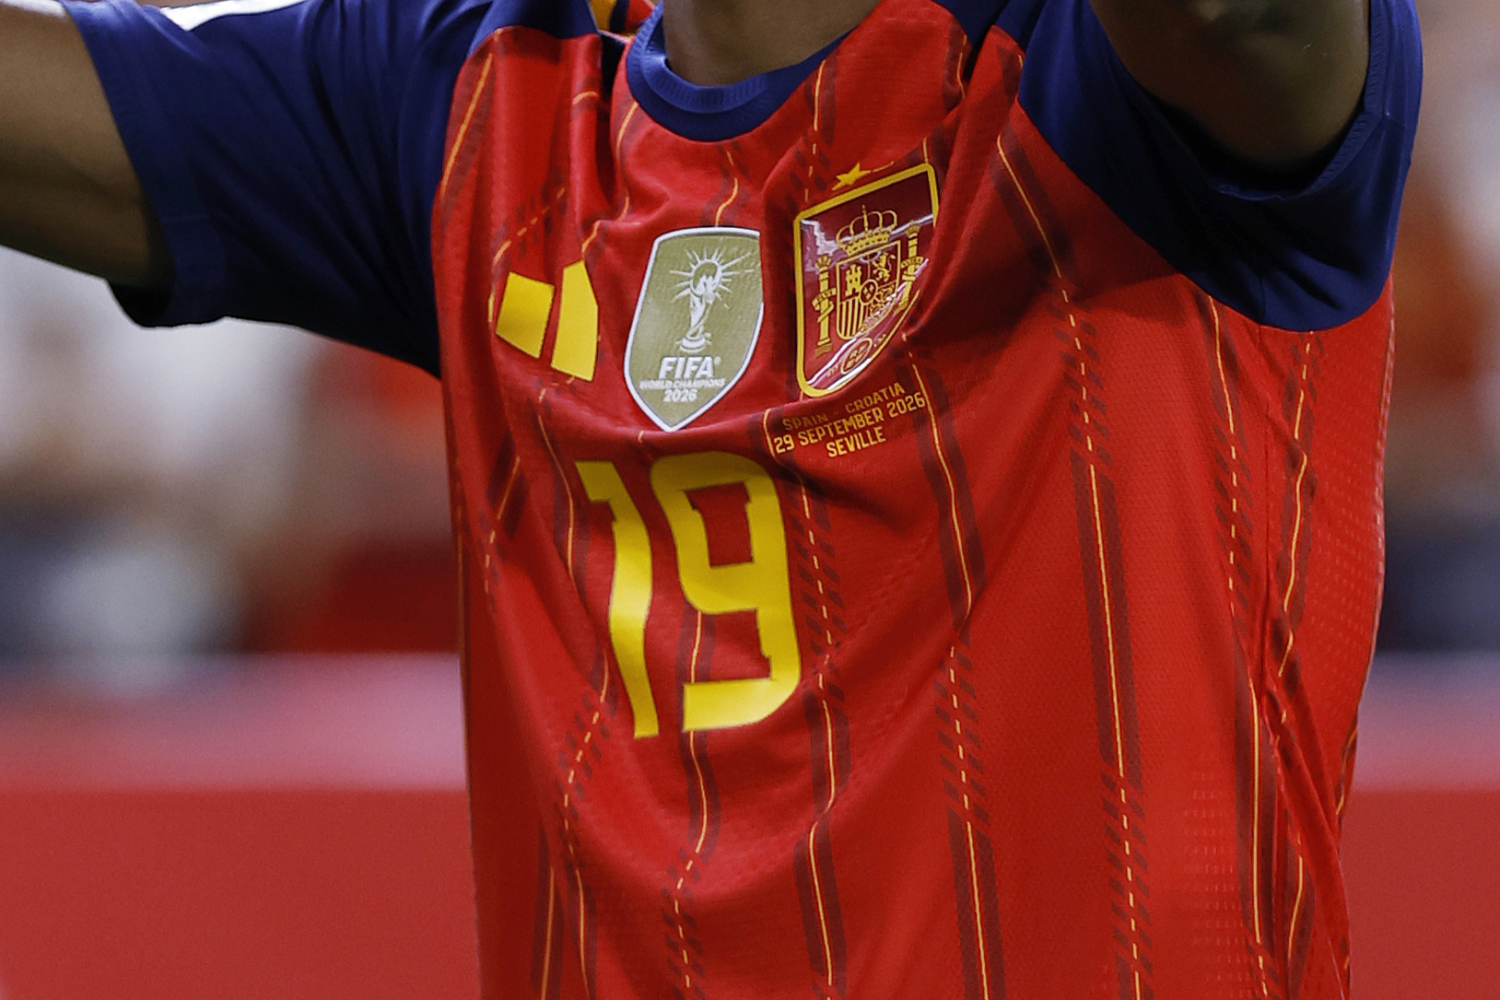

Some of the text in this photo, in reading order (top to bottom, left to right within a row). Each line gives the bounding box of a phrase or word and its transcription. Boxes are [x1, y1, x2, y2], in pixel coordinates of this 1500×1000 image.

[663, 389, 698, 403] 2026
[782, 414, 828, 431] SPAIN
[845, 382, 905, 414] CROATIA
[774, 392, 926, 454] 29 SEPTEMBER 2026
[826, 426, 886, 458] SEVILLE
[575, 450, 801, 739] 19
